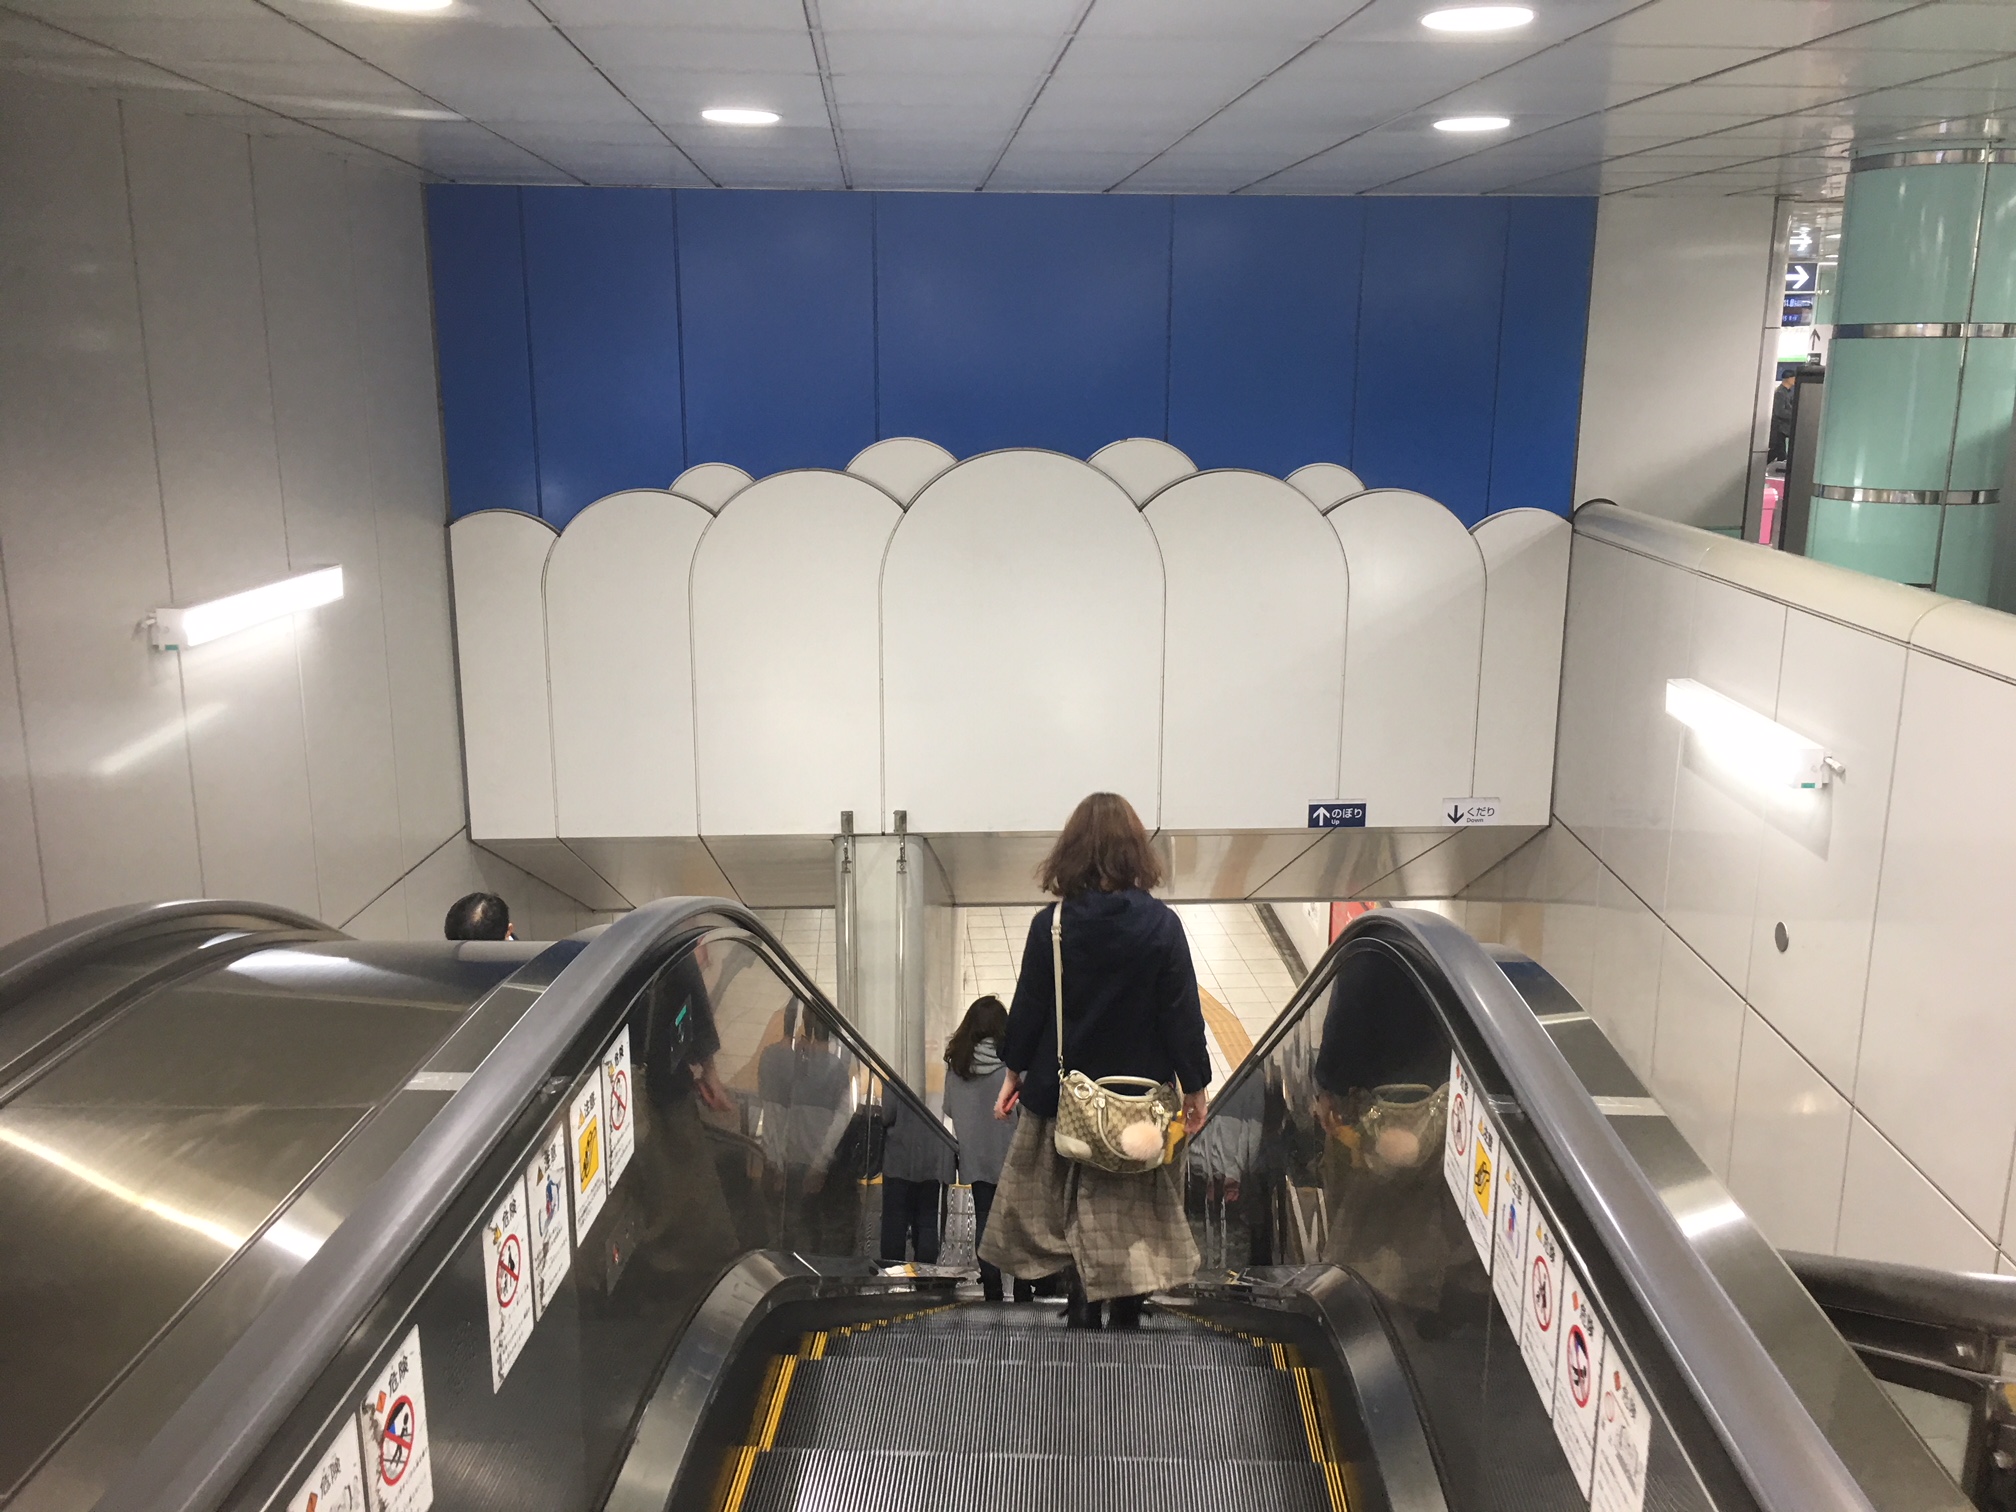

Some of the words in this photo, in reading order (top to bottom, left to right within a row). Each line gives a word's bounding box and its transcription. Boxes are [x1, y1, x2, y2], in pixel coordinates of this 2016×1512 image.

[1331, 808, 1363, 819] のぼり
[1467, 806, 1495, 817] くだり
[584, 1091, 596, 1119] 注意
[502, 1198, 517, 1231] 危険
[388, 1355, 410, 1398] 危険
[319, 1456, 343, 1500] 危険
